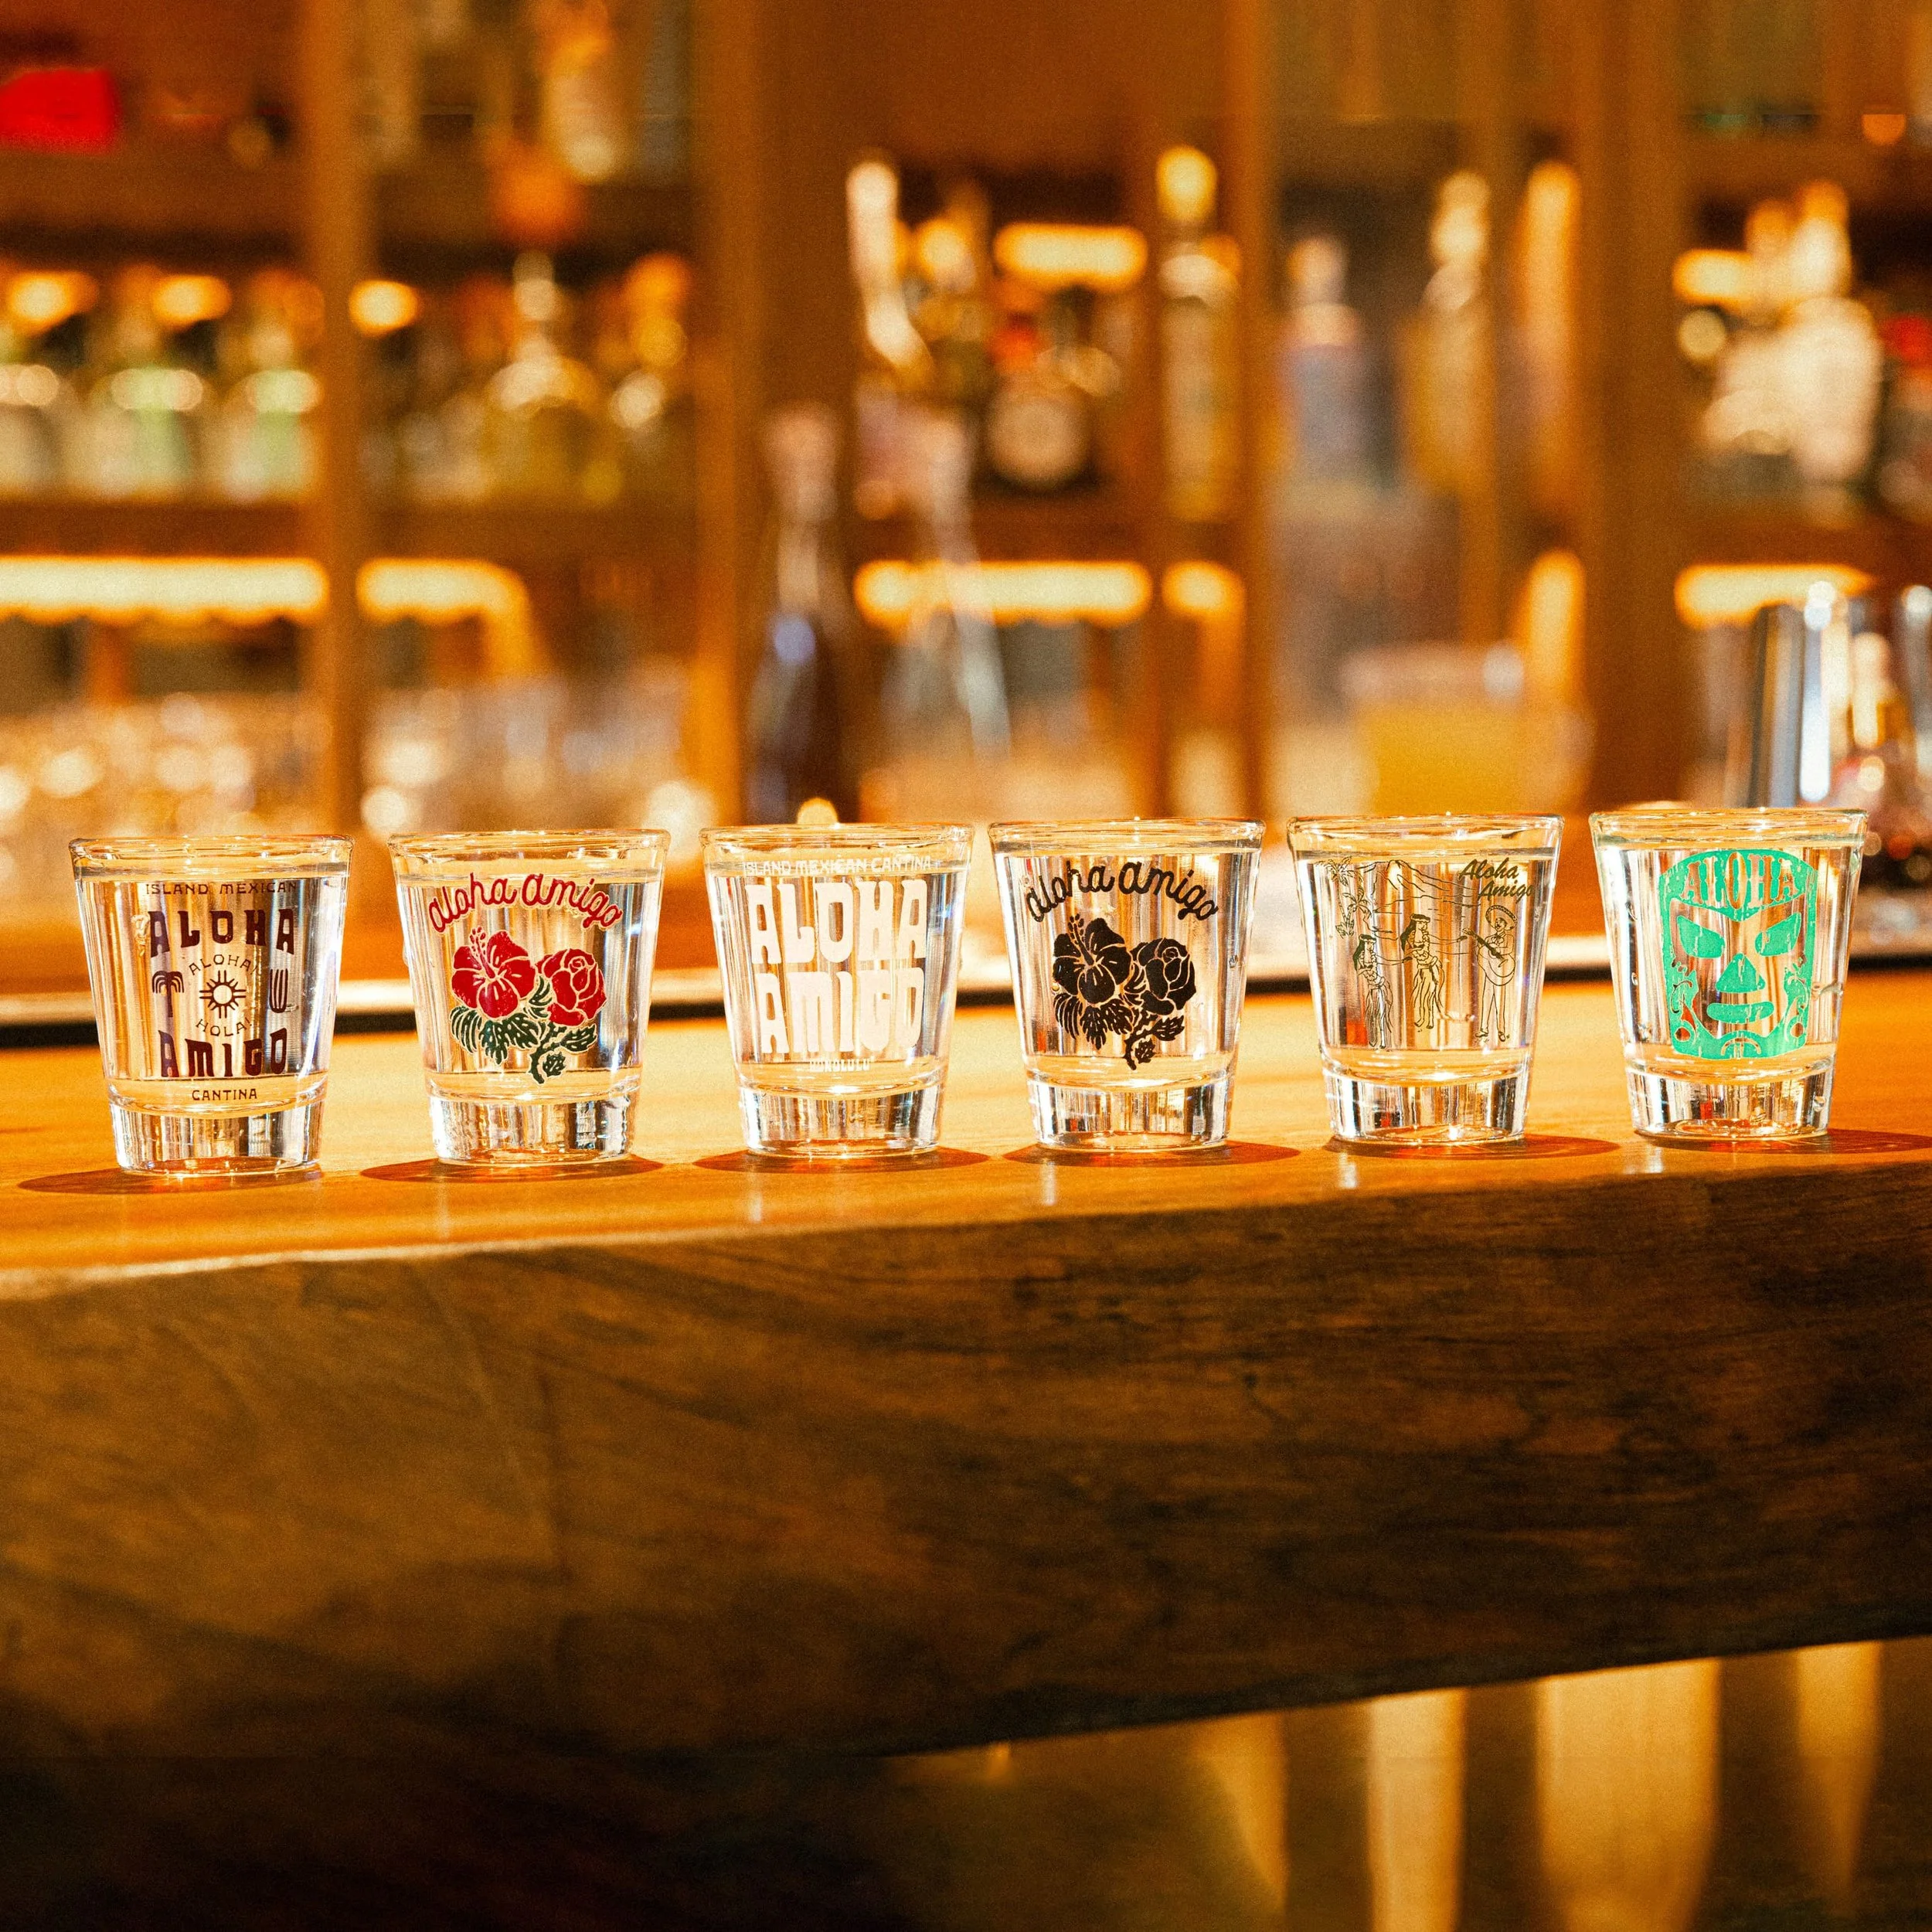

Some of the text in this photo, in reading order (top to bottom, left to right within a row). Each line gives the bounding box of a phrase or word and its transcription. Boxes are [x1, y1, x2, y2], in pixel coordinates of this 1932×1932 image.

[145, 882, 298, 896] ISLAND MEXICAN
[743, 855, 932, 876] ISLAND MEXICAN CANTINA
[1458, 857, 1519, 880] Aloha
[1681, 852, 1799, 910] ALOHA
[428, 872, 624, 933] aloha amigo
[1026, 861, 1219, 923] aloha amigo
[1478, 879, 1534, 904] Amigo
[149, 908, 295, 957] ALOHA
[745, 879, 928, 964] ALOHA
[196, 1017, 253, 1037] HOLA!
[754, 967, 925, 1054] AMIGO
[161, 1027, 288, 1078] AMIGO
[192, 1089, 257, 1101] CANTINA
